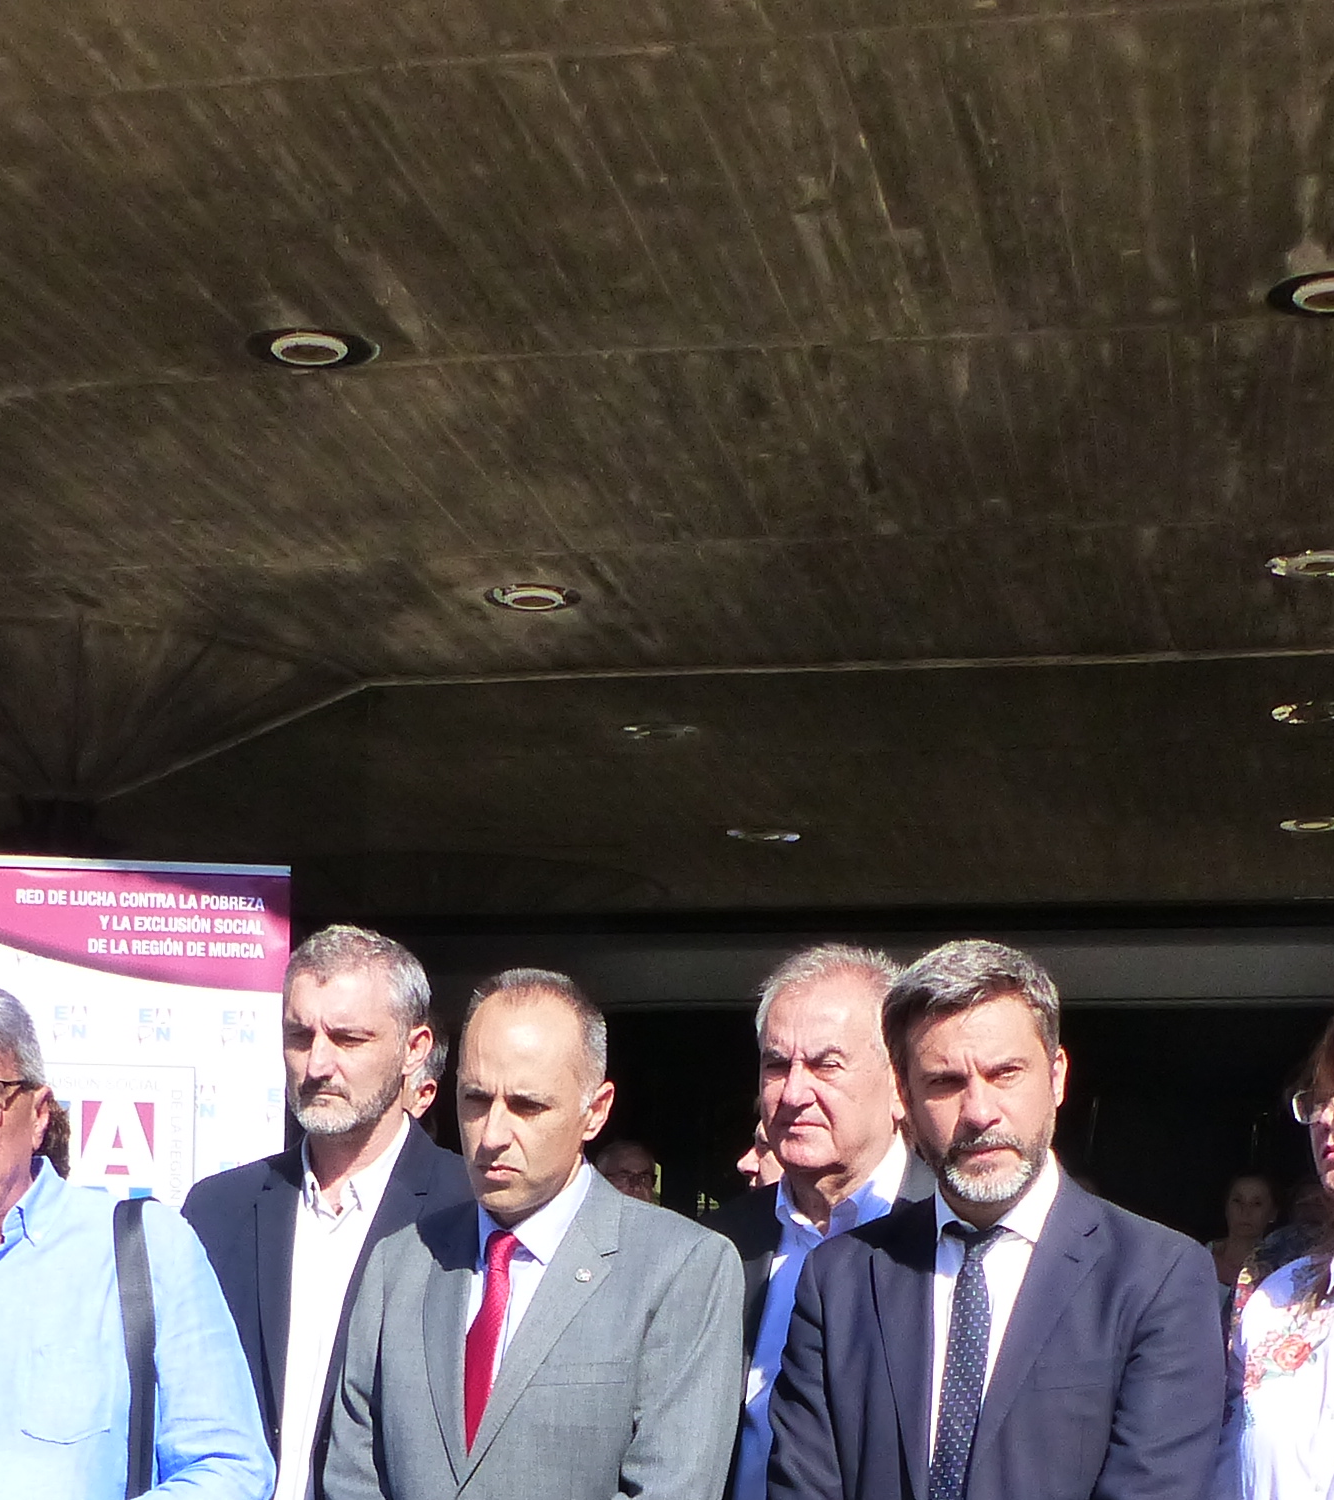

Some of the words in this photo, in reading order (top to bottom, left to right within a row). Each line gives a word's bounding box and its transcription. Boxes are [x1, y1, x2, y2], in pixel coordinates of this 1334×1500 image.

[16, 888, 45, 905] RED
[47, 889, 68, 906] DE
[69, 890, 117, 907] LUCHA
[119, 891, 177, 909] CONTRA
[178, 893, 199, 910] LA
[200, 894, 266, 912] POBREZA
[99, 914, 111, 931] Y
[112, 915, 132, 932] LA
[133, 914, 212, 934] EXCLUSIÓN
[213, 918, 266, 936] SOCIAL
[87, 938, 108, 954] DE
[109, 939, 130, 955] LA
[131, 937, 182, 956] REGIÓN
[188, 941, 207, 957] DE
[208, 942, 266, 960] MURCIA
